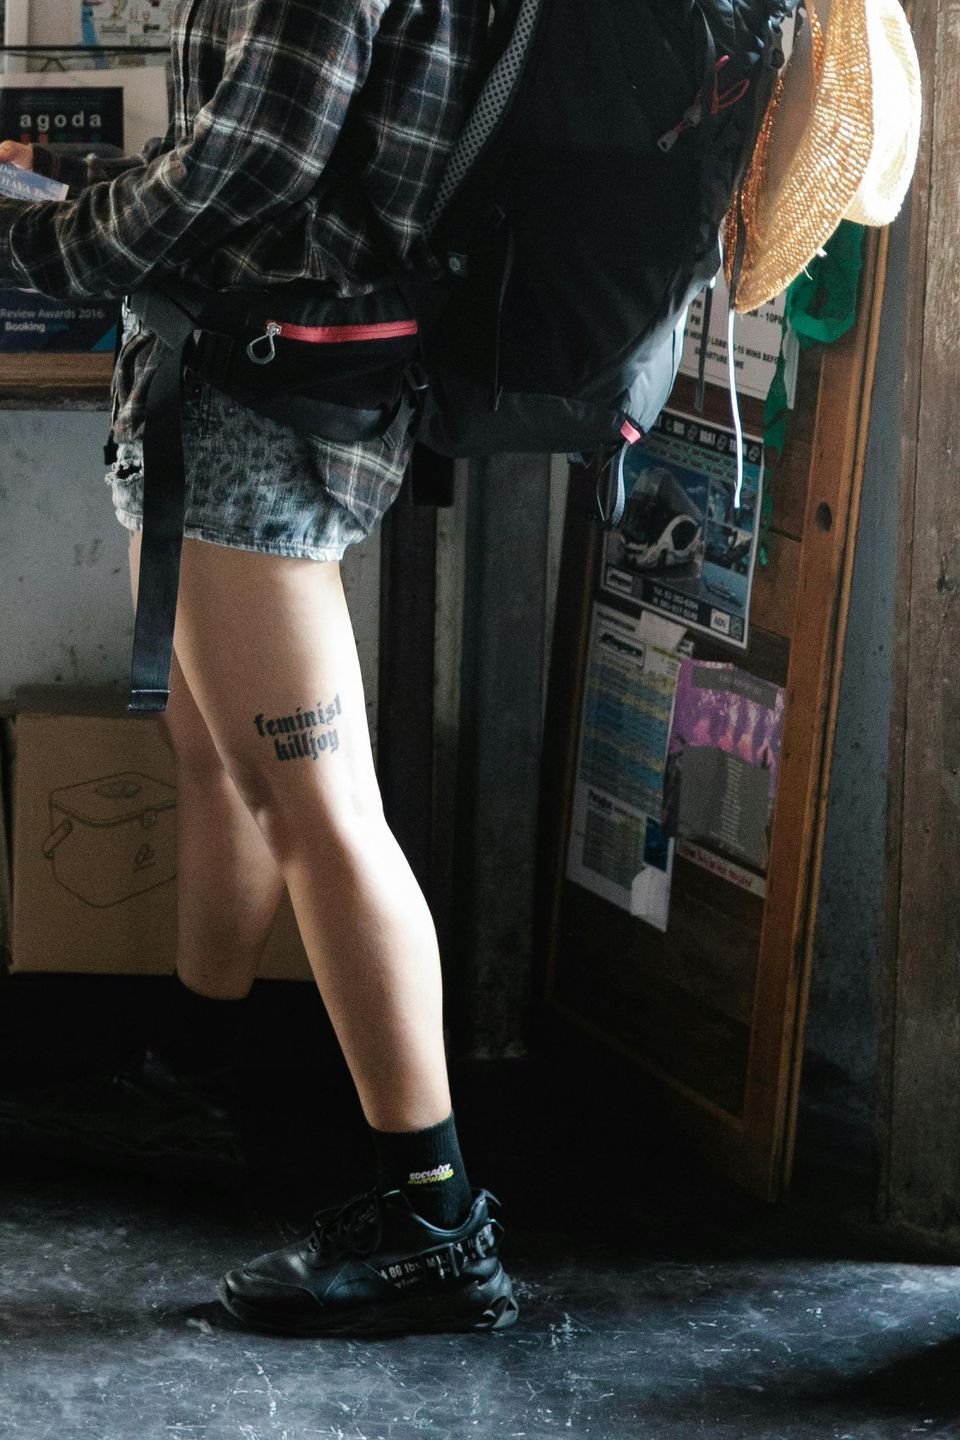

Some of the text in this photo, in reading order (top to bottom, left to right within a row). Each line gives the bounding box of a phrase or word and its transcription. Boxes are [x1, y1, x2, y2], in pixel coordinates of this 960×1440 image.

[0, 309, 36, 319] Review
[38, 309, 76, 319] Awards
[253, 693, 342, 738] feminist
[273, 728, 339, 762] killjoy
